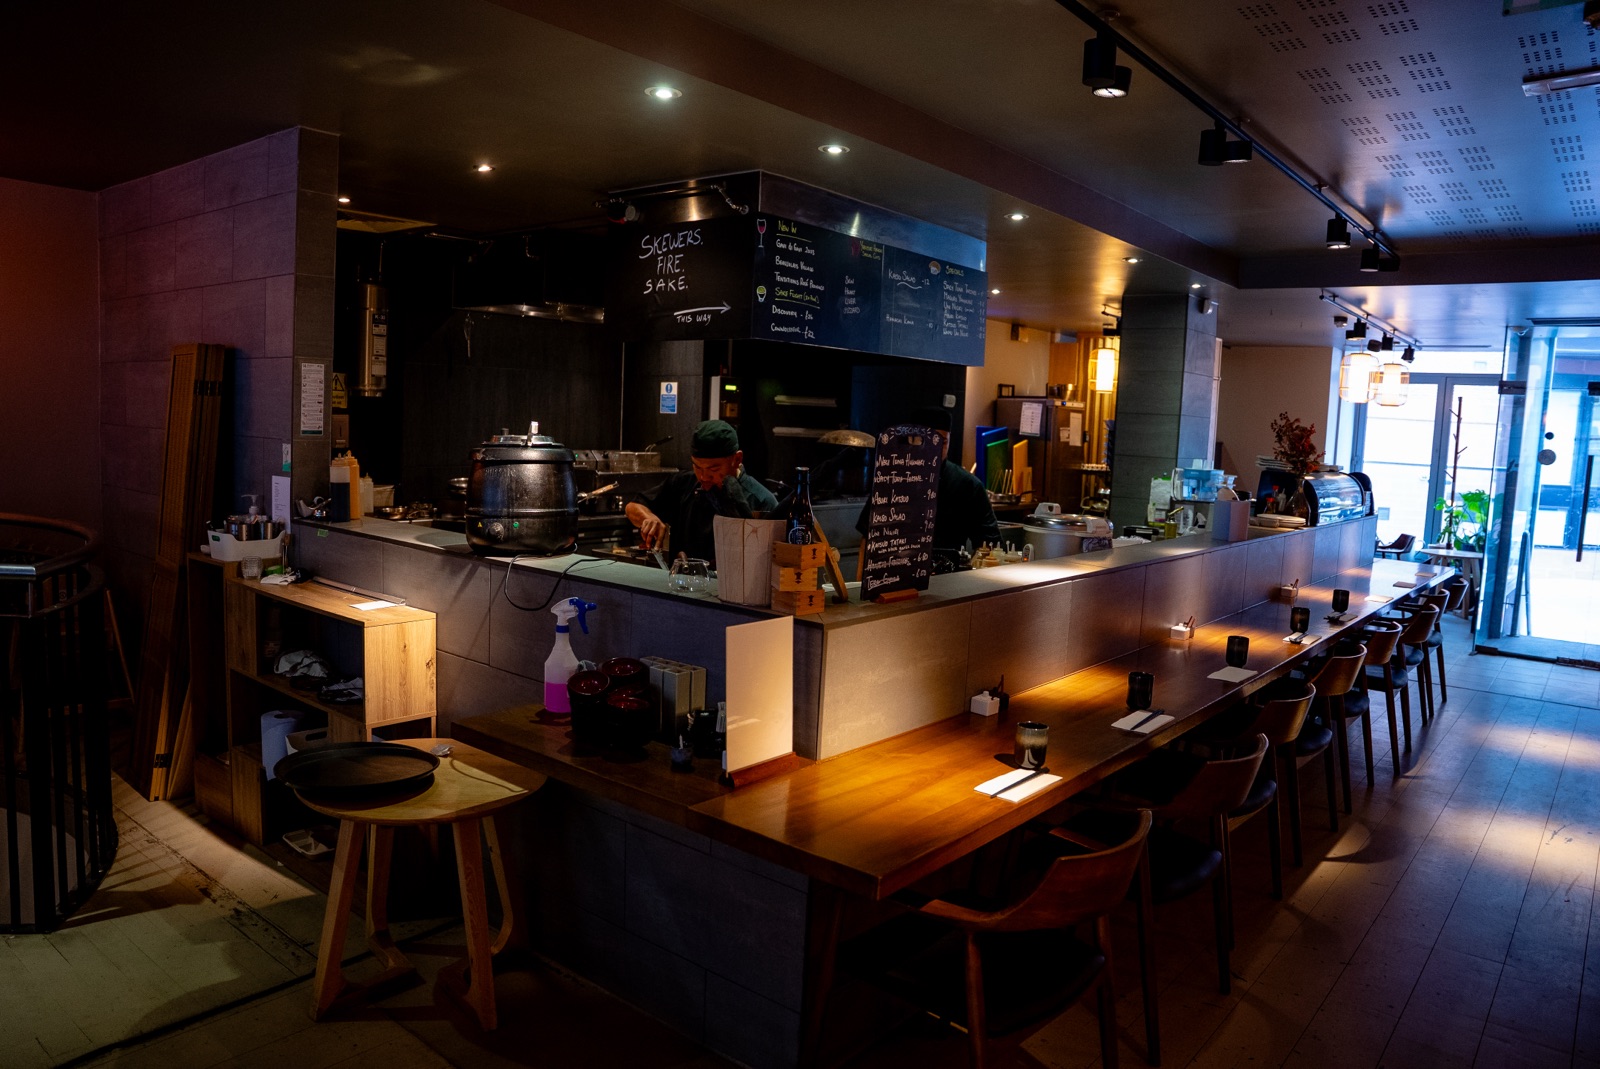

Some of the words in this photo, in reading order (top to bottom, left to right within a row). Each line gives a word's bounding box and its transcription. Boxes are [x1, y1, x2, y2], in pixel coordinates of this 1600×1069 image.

[639, 228, 704, 259] SKEWERS.
[657, 254, 685, 275] FIRE.
[643, 275, 689, 295] SAKE.
[676, 314, 693, 324] THIS
[696, 313, 712, 326] WAY
[895, 425, 926, 436] SPECIALS
